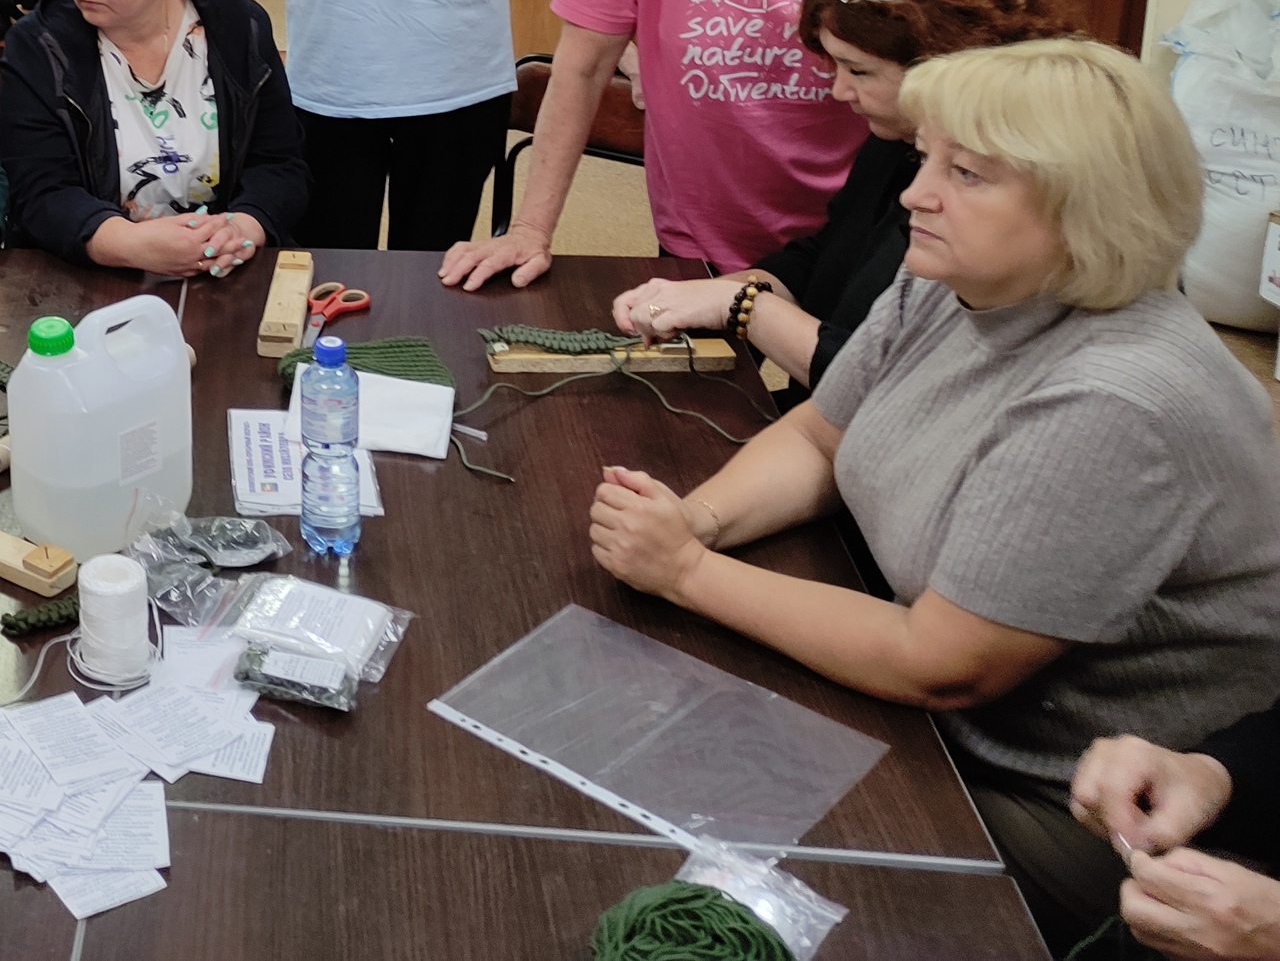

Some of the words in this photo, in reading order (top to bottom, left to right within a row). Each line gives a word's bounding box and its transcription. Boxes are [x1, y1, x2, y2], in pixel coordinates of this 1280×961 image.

[679, 16, 765, 39] save
[682, 37, 803, 68] nature
[680, 69, 834, 103] Outventur
